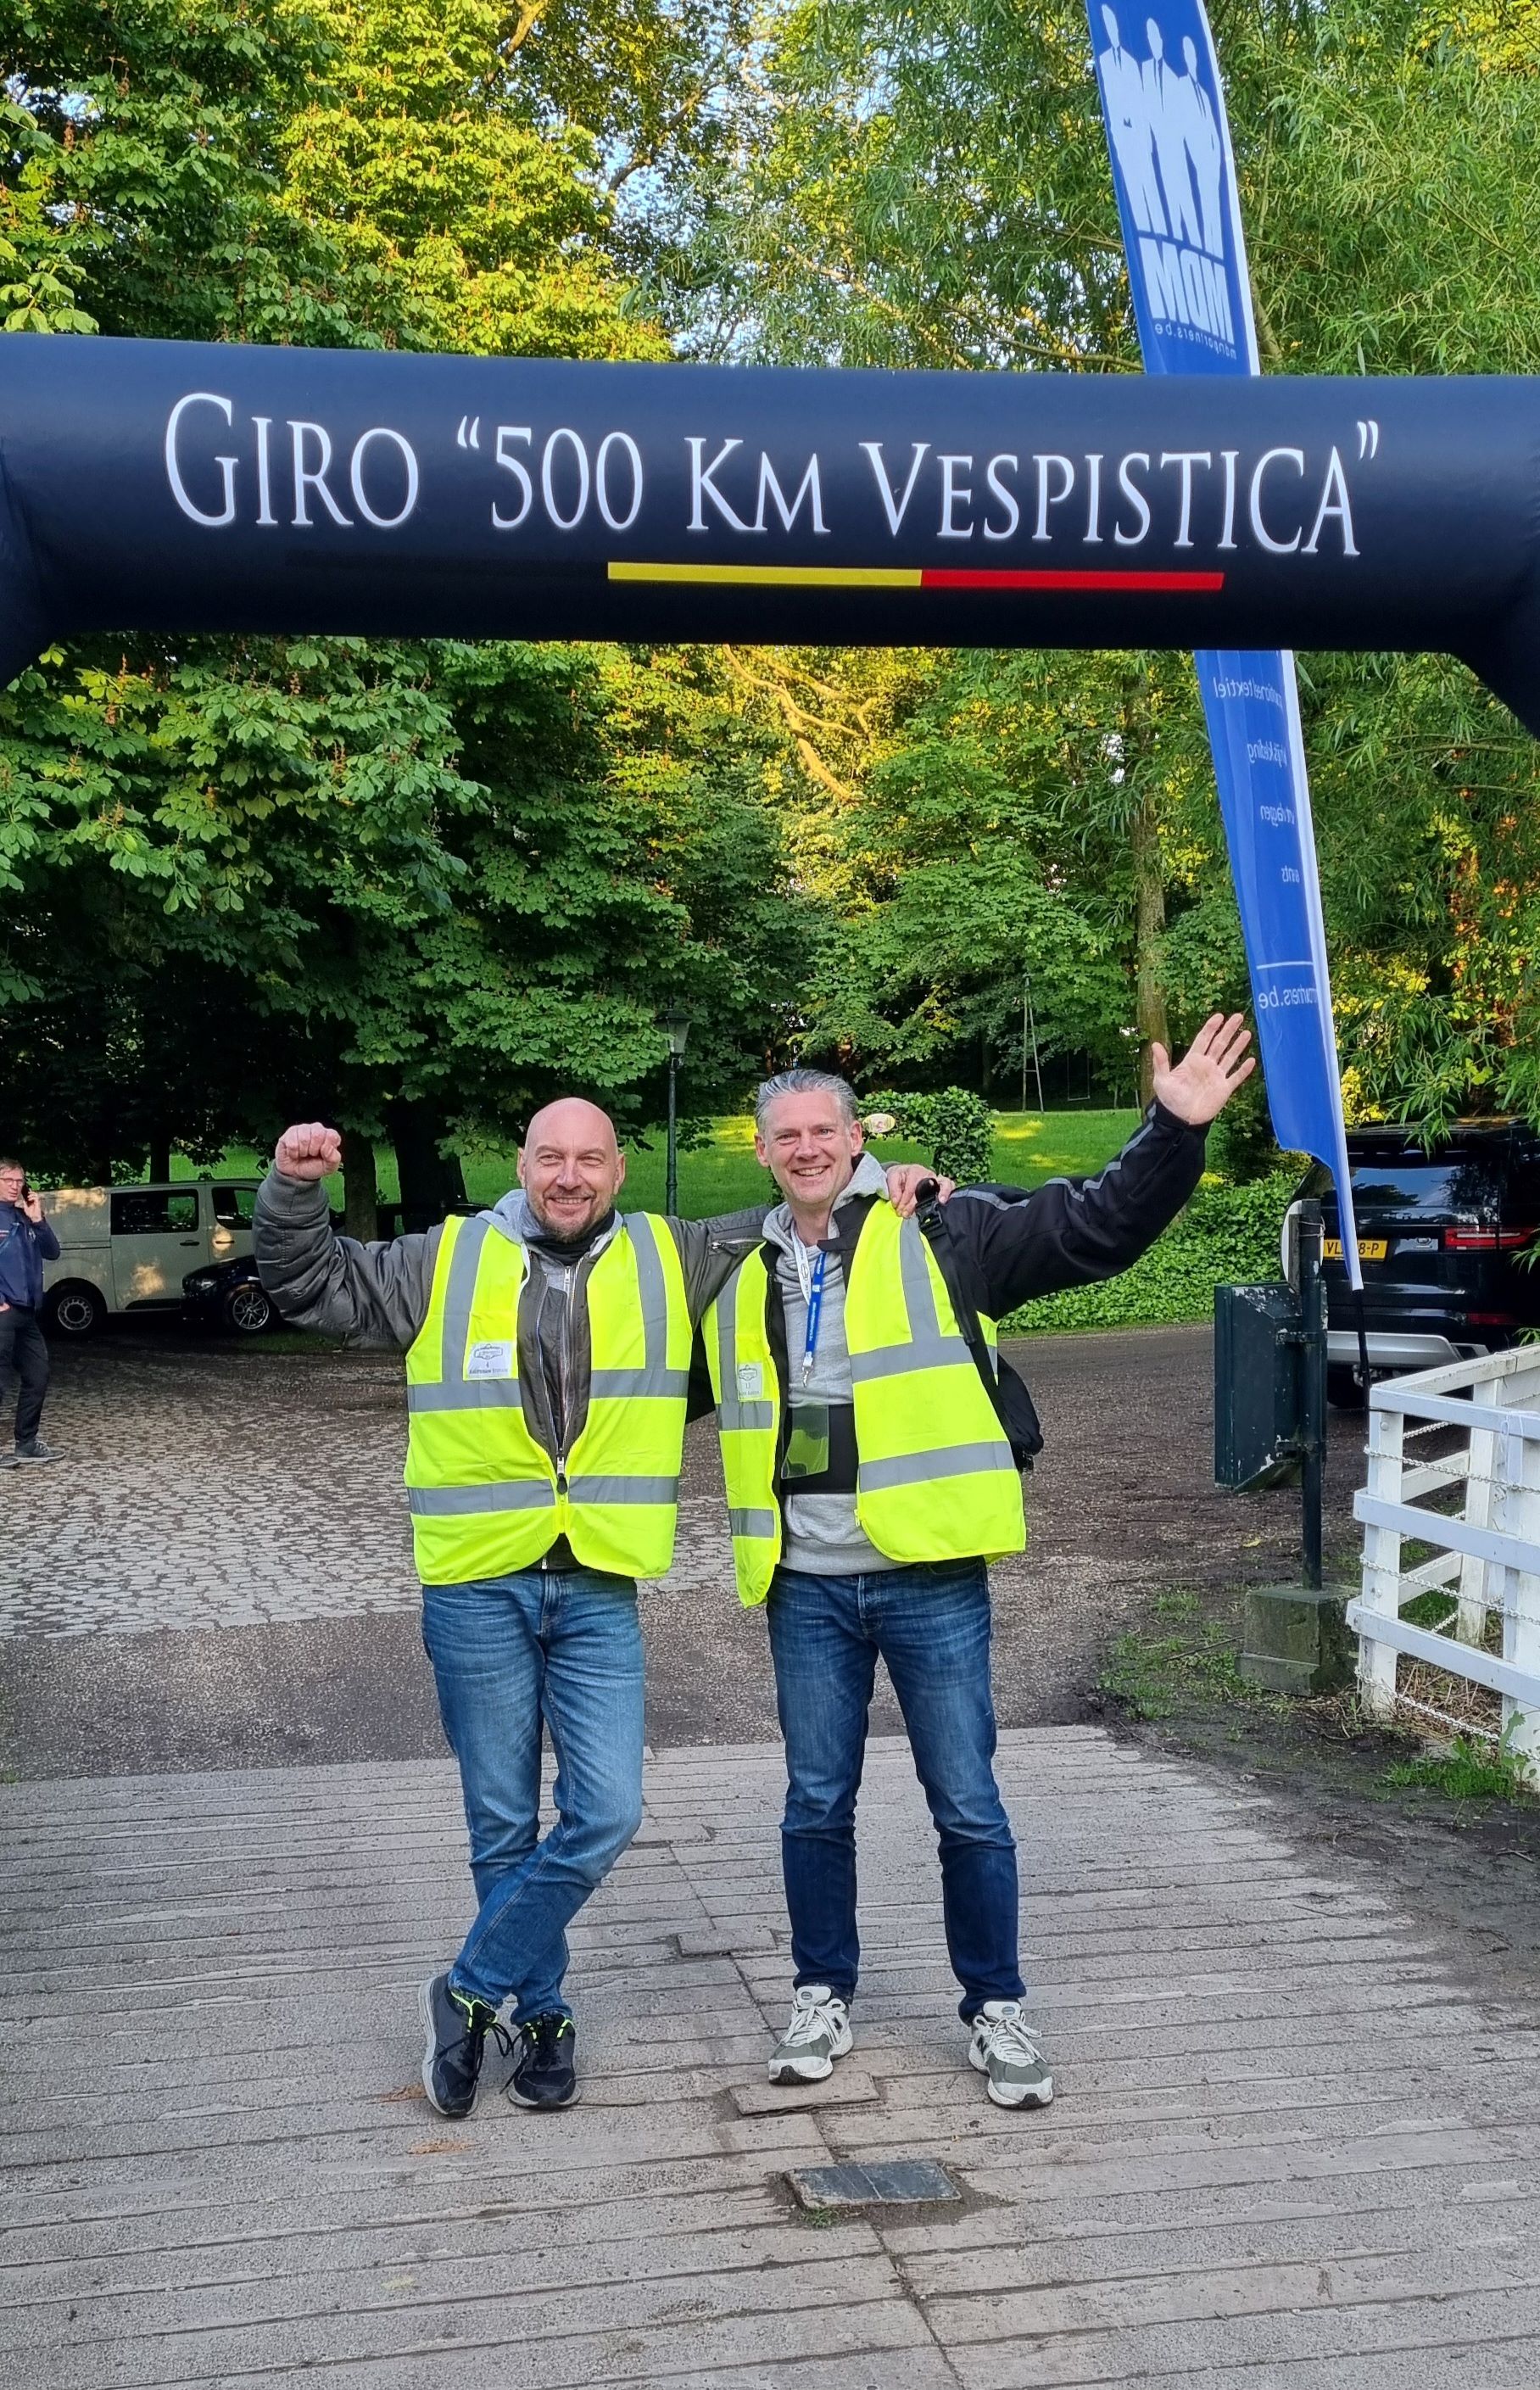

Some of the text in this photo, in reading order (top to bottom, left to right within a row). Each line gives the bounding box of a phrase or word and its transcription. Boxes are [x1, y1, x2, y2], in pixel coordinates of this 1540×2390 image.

[165, 392, 420, 528] GIRO
[684, 437, 832, 534] KM
[858, 420, 1380, 556] VESPISTICA”
